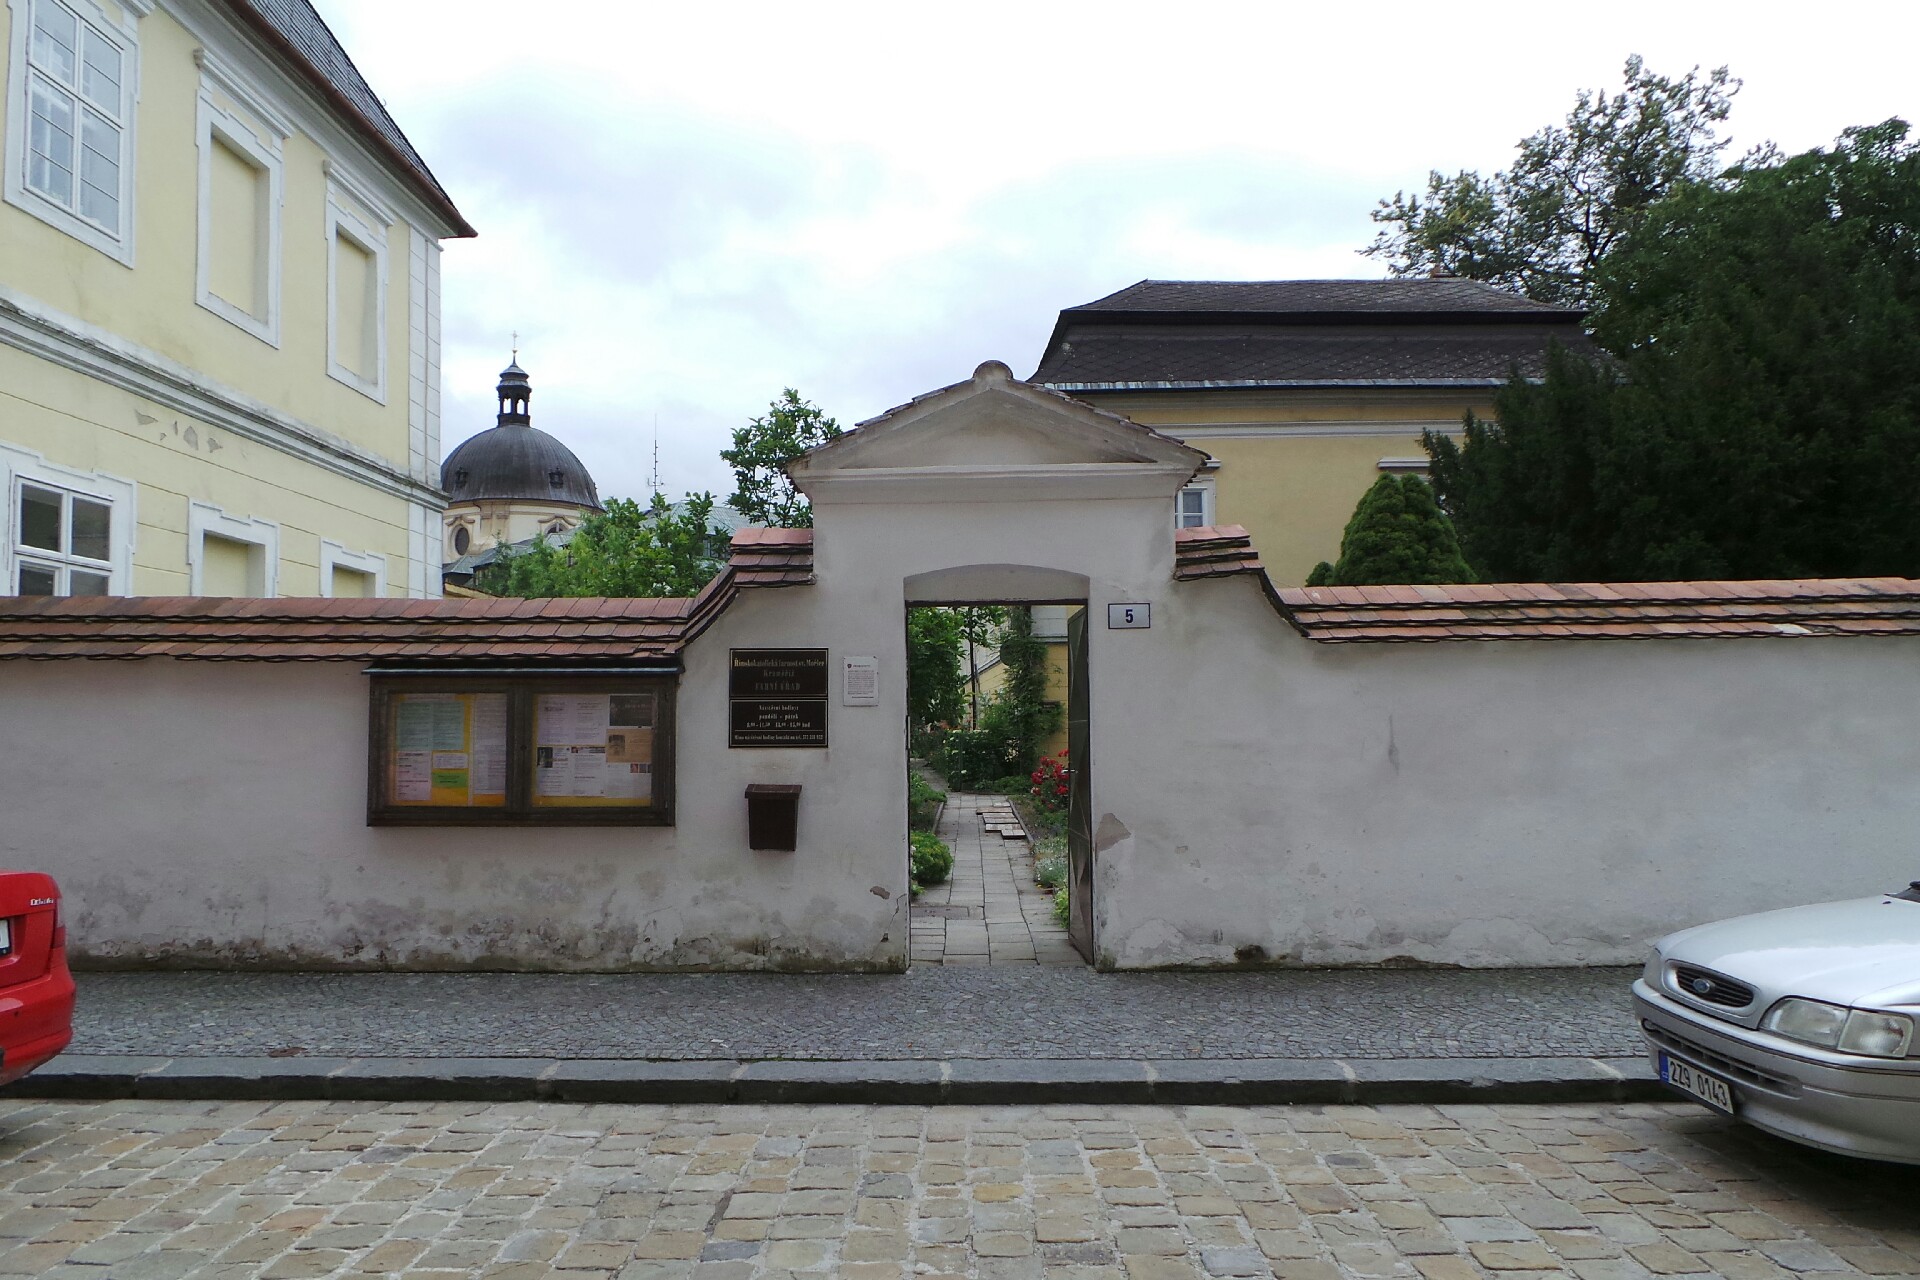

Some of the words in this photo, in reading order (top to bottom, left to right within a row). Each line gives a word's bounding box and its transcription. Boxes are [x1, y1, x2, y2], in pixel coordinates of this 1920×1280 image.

[1126, 609, 1133, 623] 5
[1670, 1060, 1691, 1088] 2Z9
[1697, 1074, 1727, 1106] 0143
